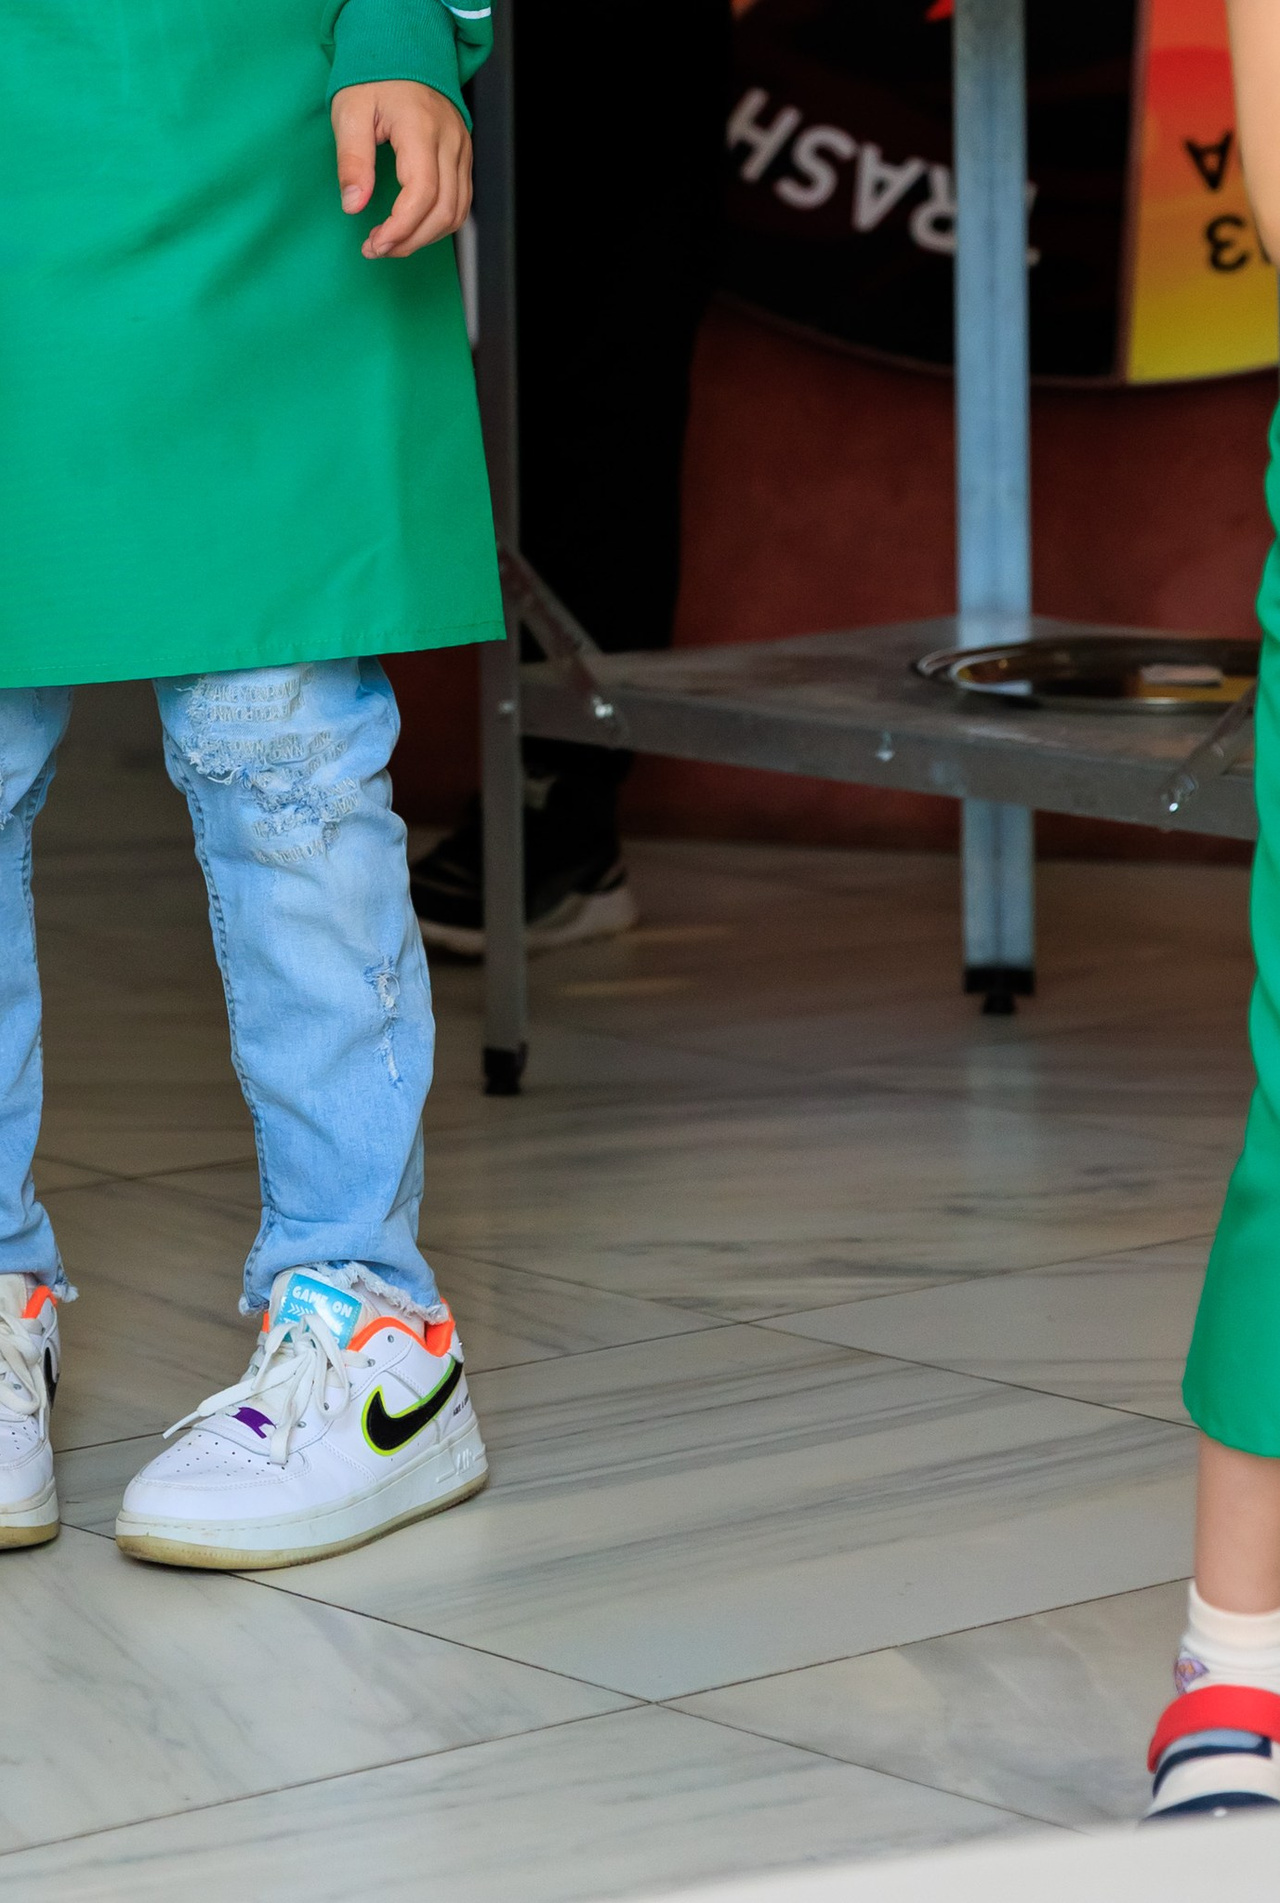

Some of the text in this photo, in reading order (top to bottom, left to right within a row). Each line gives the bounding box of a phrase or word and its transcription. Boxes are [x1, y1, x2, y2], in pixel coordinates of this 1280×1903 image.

[725, 87, 1040, 267] RASH
[292, 1285, 353, 1318] GAME ON
